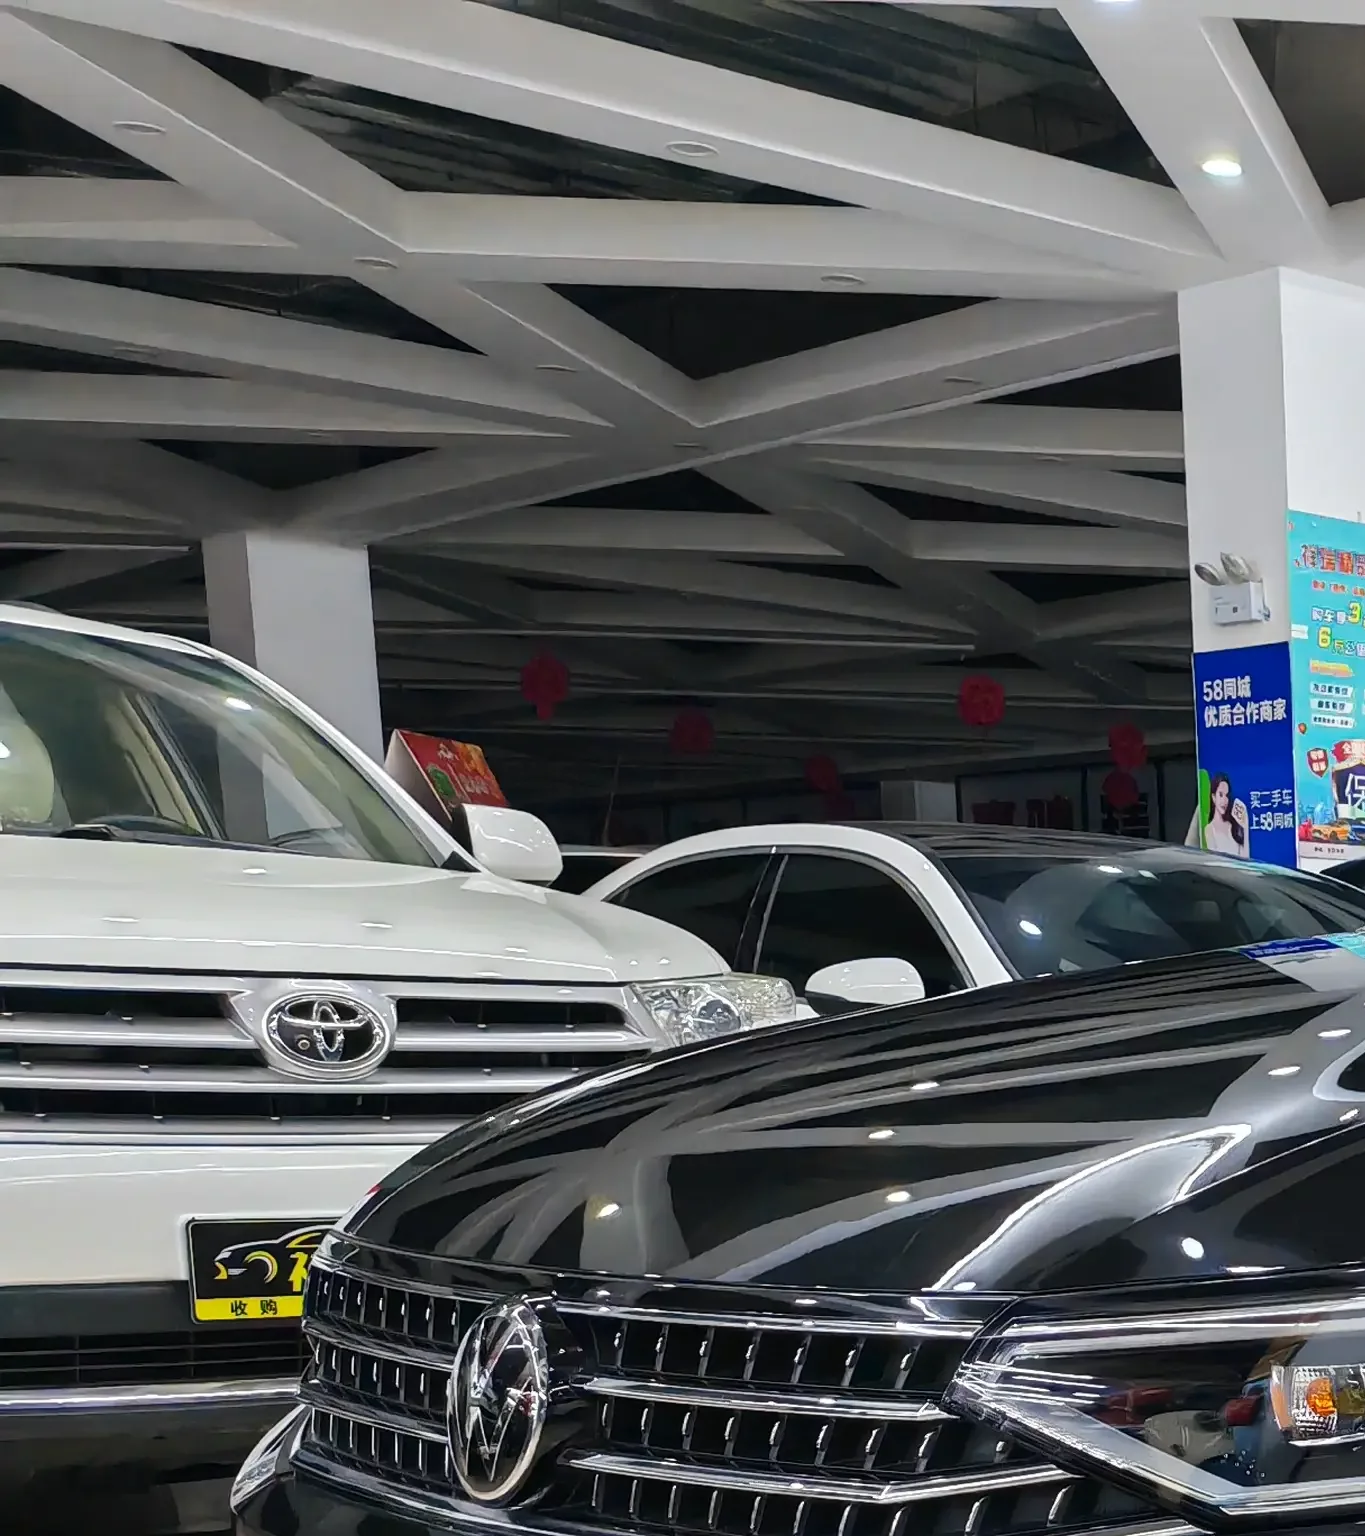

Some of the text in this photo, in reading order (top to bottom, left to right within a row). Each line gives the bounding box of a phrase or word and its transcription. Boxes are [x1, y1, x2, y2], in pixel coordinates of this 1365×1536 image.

[1203, 675, 1251, 702] 58同城
[1204, 698, 1287, 728] 优质合作商家
[1250, 788, 1293, 809] 买二手车
[1250, 812, 1294, 831] 上58同城
[230, 1300, 278, 1316] 收购
